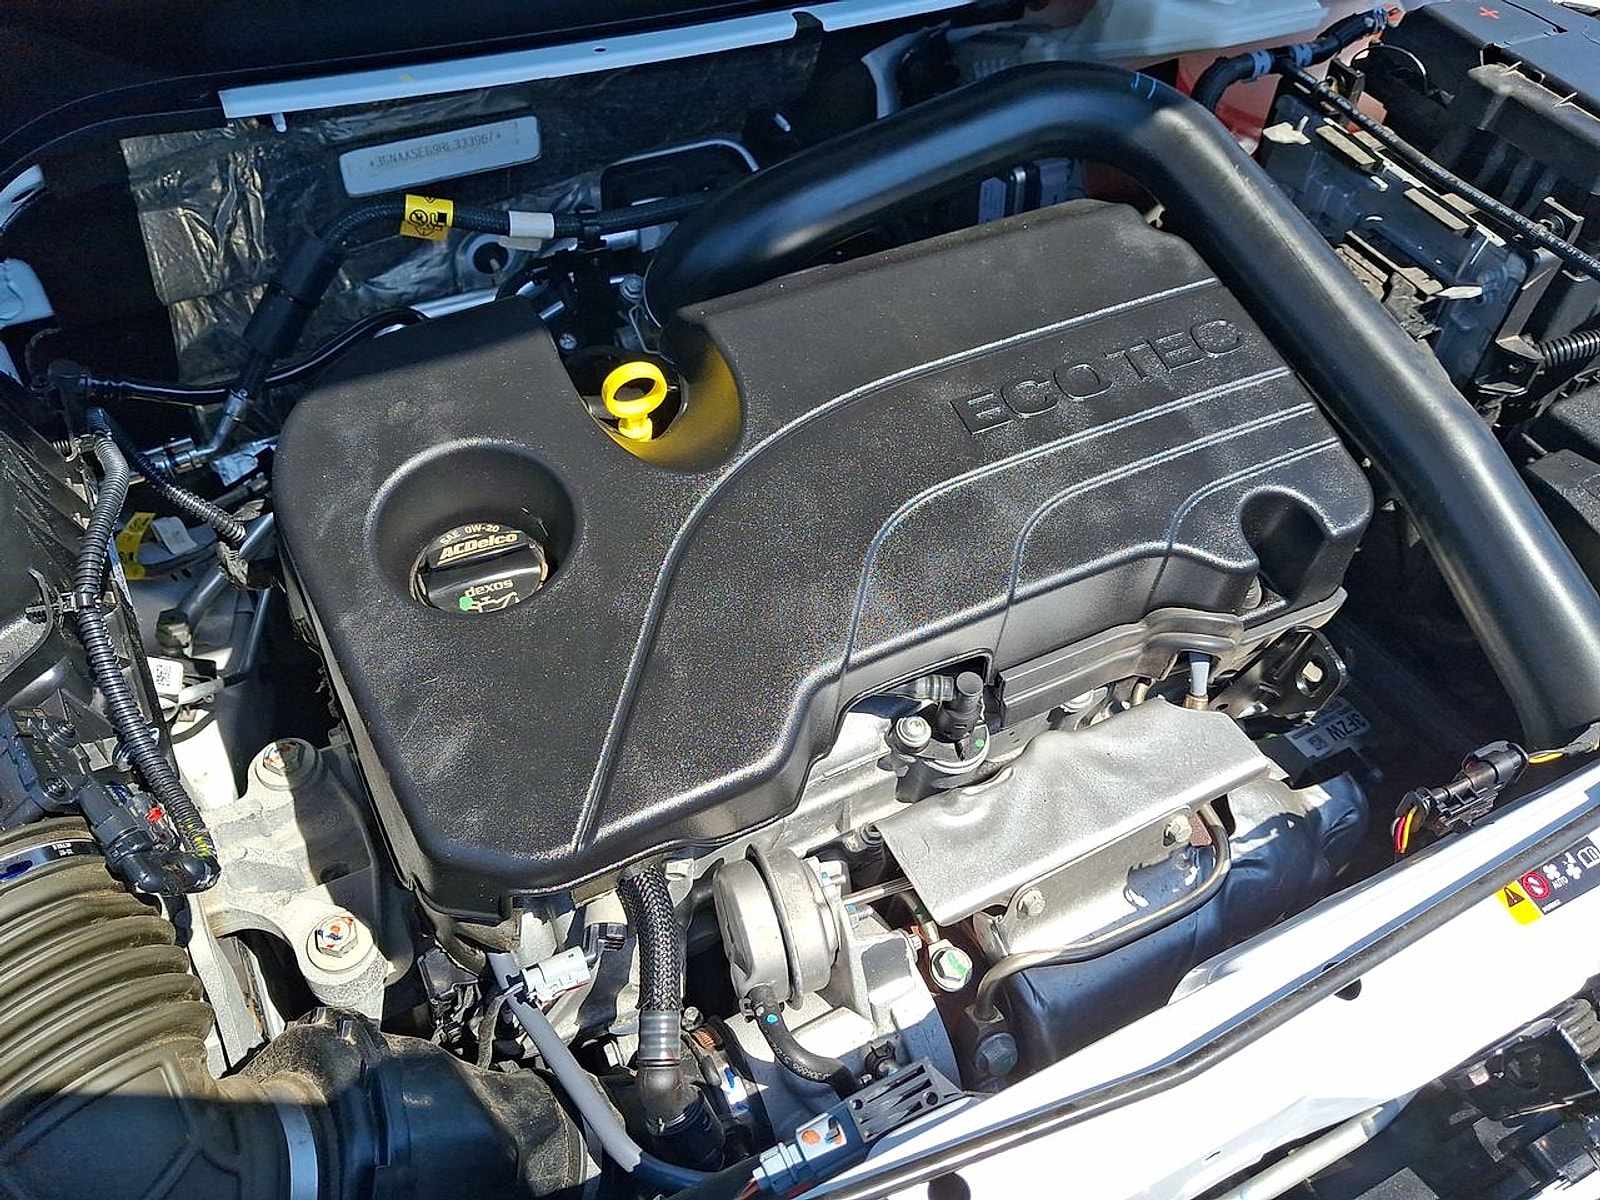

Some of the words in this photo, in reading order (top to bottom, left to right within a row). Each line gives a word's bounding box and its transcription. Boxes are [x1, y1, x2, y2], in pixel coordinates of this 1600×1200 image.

[950, 320, 1244, 434] ECOTEC
[440, 530, 461, 546] SAE
[464, 523, 500, 534] 0W-20
[440, 533, 518, 560] ACDelco
[464, 579, 514, 598] dexos
[1551, 876, 1569, 890] AUTO
